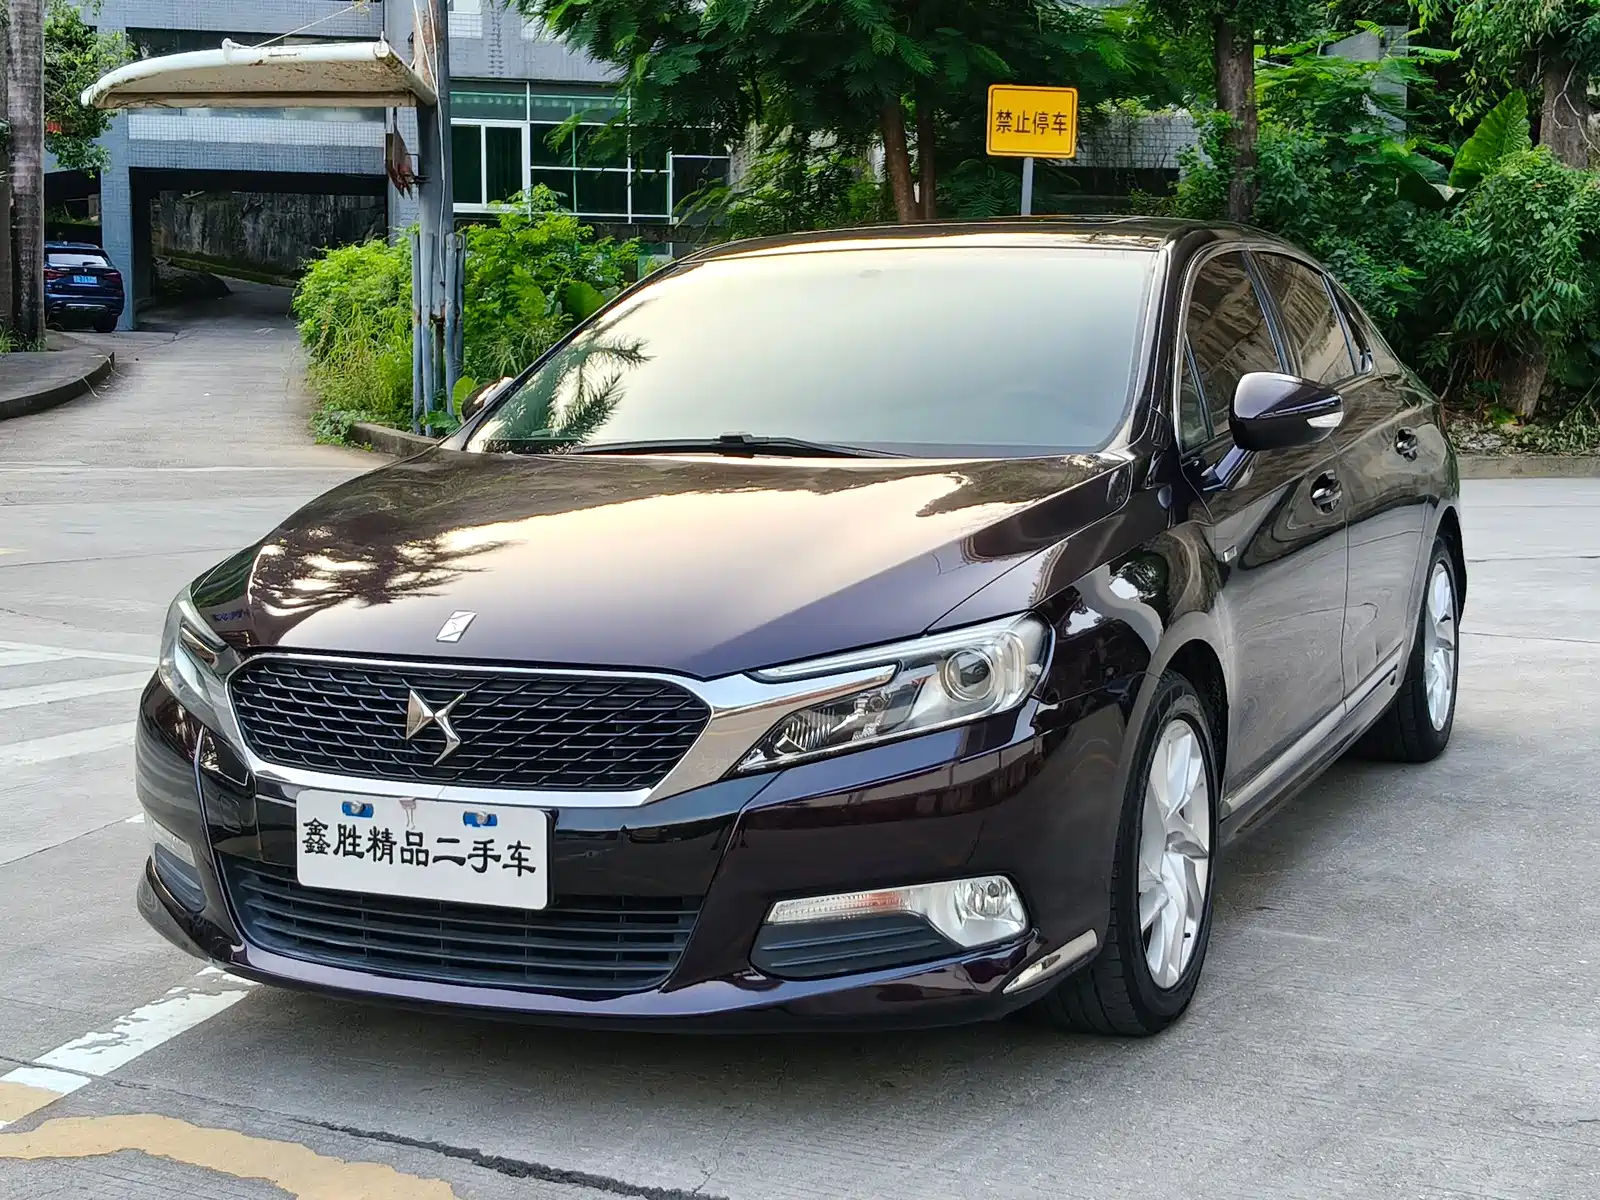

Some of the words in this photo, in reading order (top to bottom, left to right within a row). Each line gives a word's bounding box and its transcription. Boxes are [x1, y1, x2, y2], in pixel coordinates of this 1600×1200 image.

[996, 109, 1068, 136] 禁止停车
[302, 818, 536, 877] 鑫胜精品二手车
